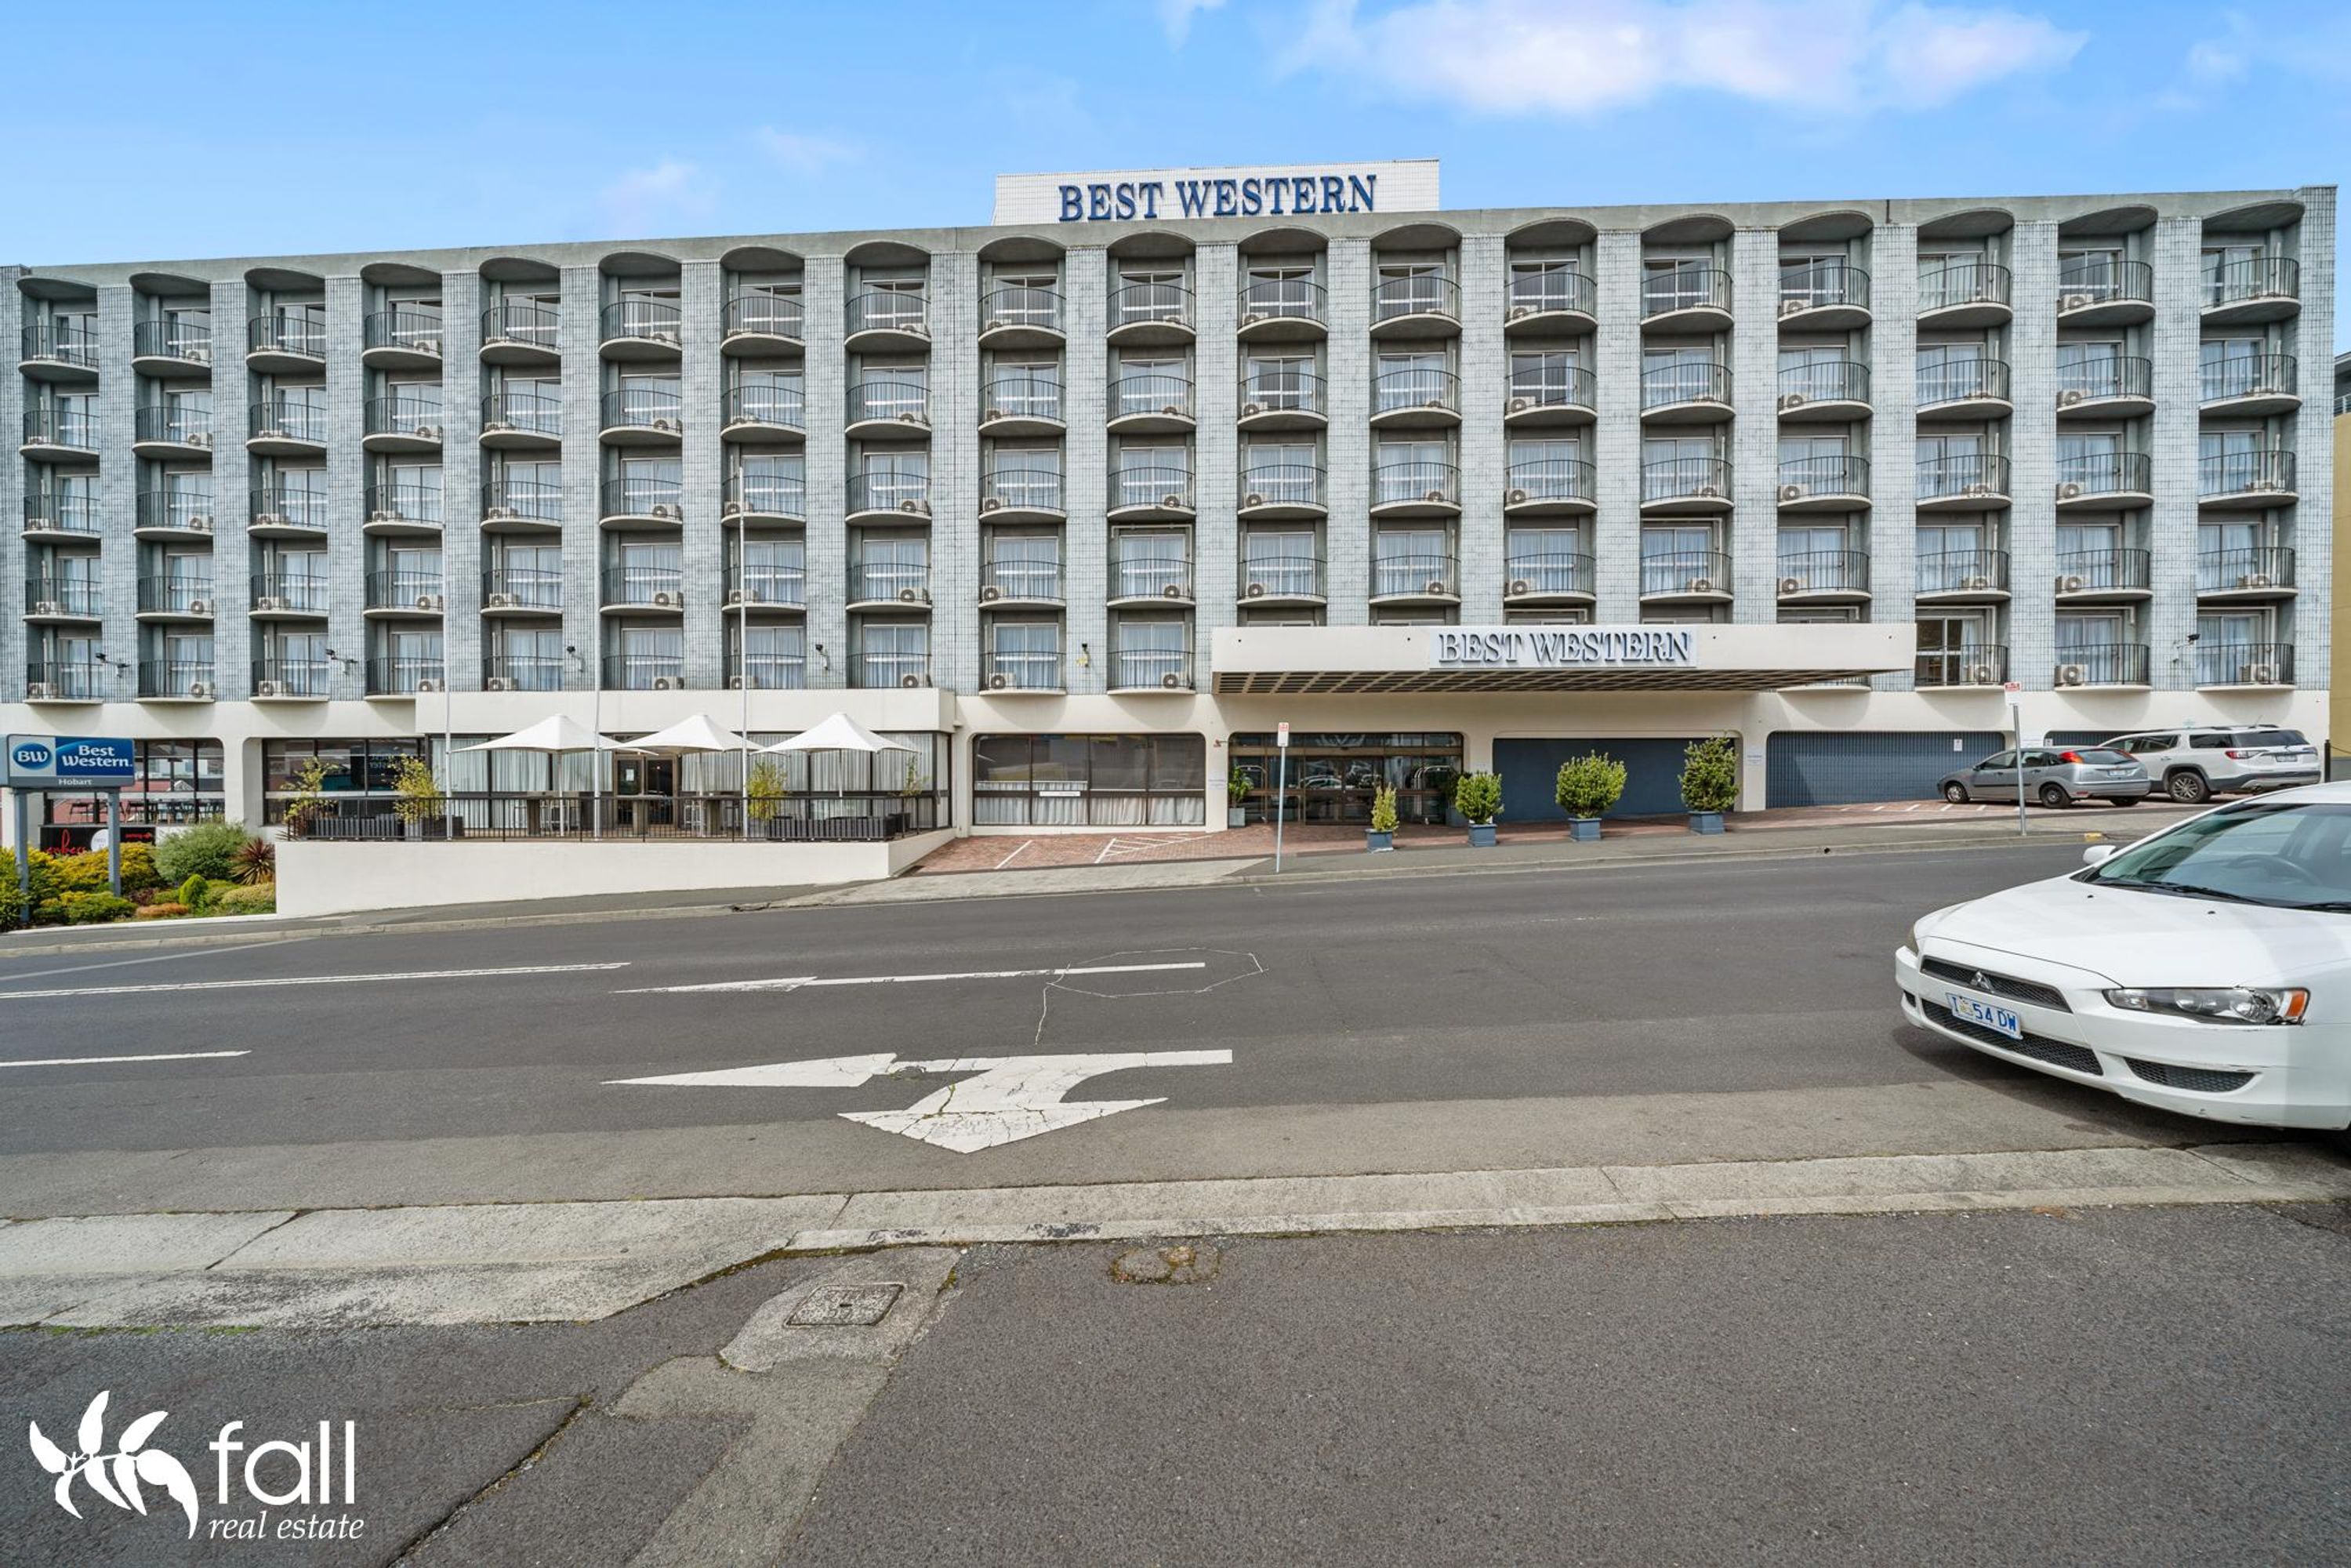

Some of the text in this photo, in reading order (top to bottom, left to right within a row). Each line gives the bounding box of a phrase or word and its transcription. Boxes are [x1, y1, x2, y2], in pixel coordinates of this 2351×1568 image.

[1058, 174, 1377, 222] BEST WESTERN
[1438, 631, 1690, 663] BEST WESTERN
[17, 750, 49, 763] BW
[78, 745, 115, 757] Best
[1972, 1003, 1994, 1023] 54
[1997, 1009, 2017, 1032] DW
